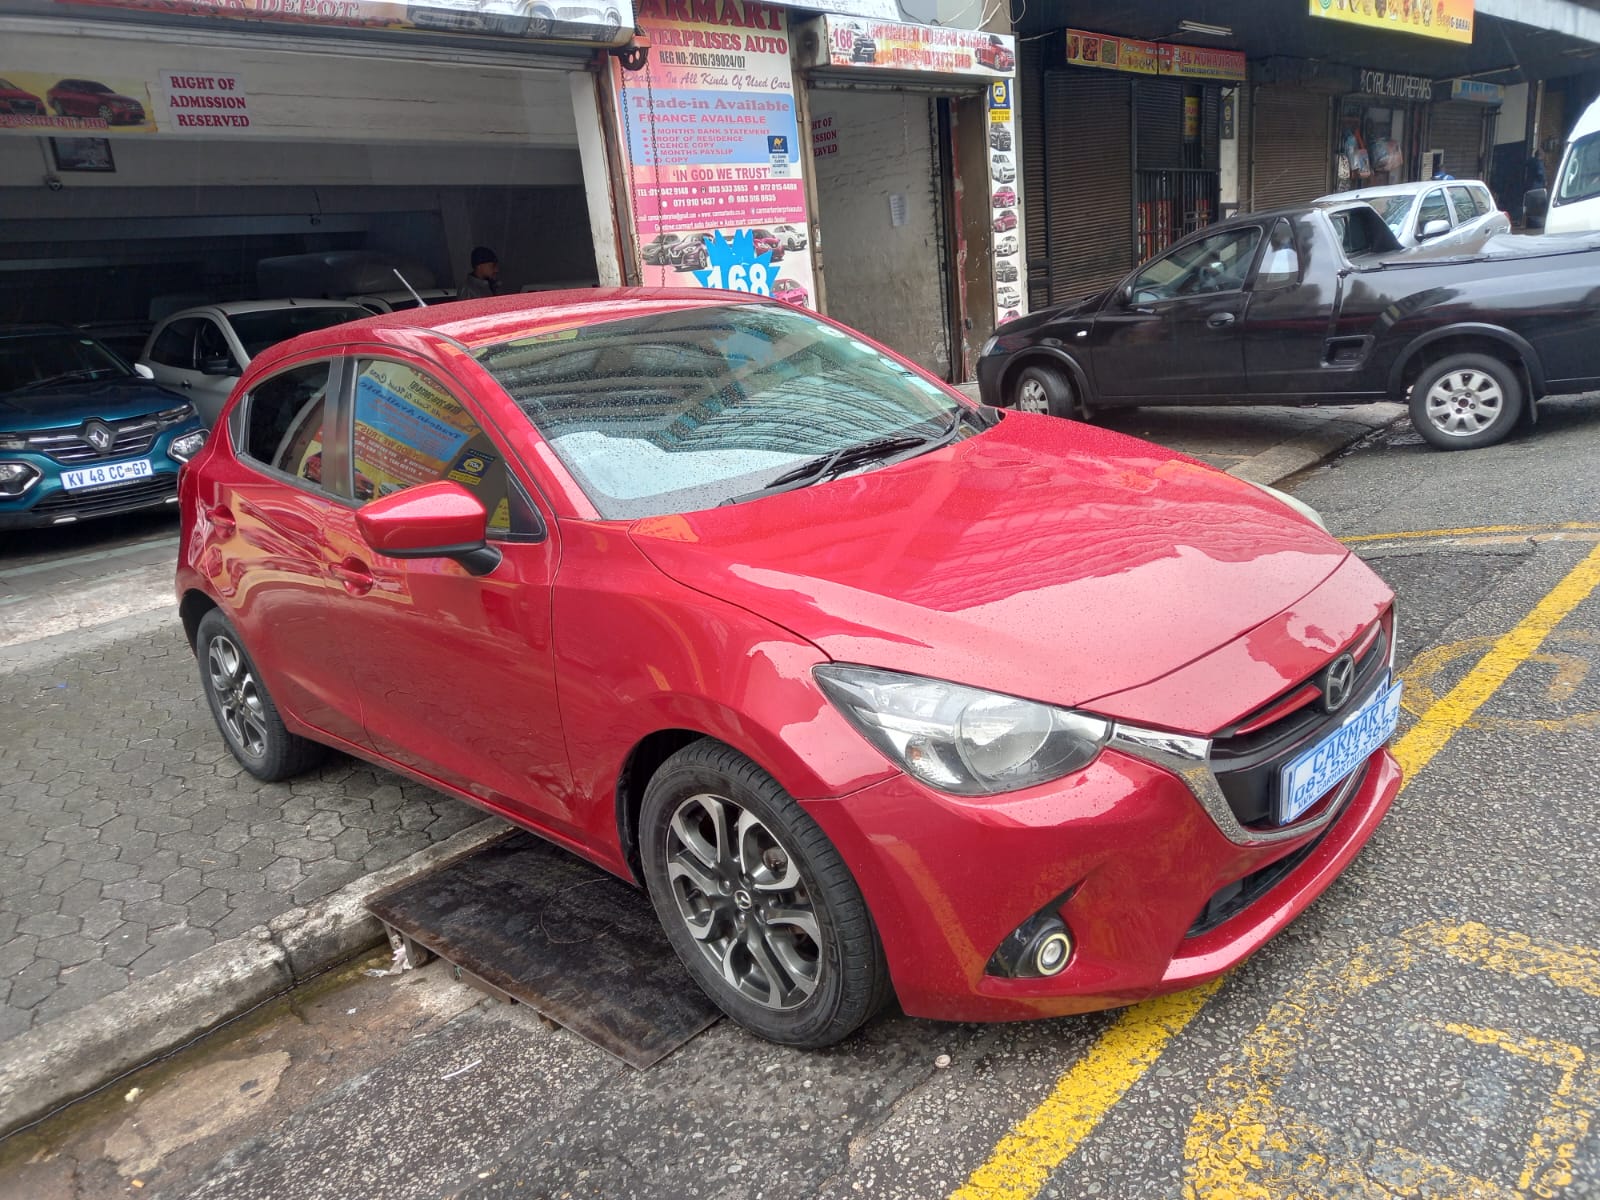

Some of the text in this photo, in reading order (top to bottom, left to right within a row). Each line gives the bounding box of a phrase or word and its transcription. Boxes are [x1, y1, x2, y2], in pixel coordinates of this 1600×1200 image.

[637, 0, 785, 30] ARMART
[743, 35, 788, 55] AUTO
[832, 28, 852, 49] 168
[660, 50, 746, 68] REG NO: 2016/39024/07
[170, 76, 235, 91] RIGHT OF
[680, 72, 698, 84] All
[700, 73, 728, 86] Kinds
[731, 74, 744, 88] Of
[745, 75, 768, 88] Used
[770, 78, 791, 90] Cars
[170, 95, 247, 109] ADMISSION
[632, 95, 790, 112] Trade-in Available
[177, 114, 250, 127] RESERVED
[639, 113, 767, 124] FINANCE AVAILABLE
[822, 117, 832, 127] OF
[690, 168, 714, 180] GOD
[716, 167, 733, 180] WE
[705, 262, 767, 297] 168
[67, 473, 84, 487] KV
[90, 469, 106, 483] 48
[110, 466, 125, 480] CC
[133, 461, 148, 476] GP
[1312, 696, 1390, 773] CARMART
[1294, 706, 1399, 803] 083 533 3653
